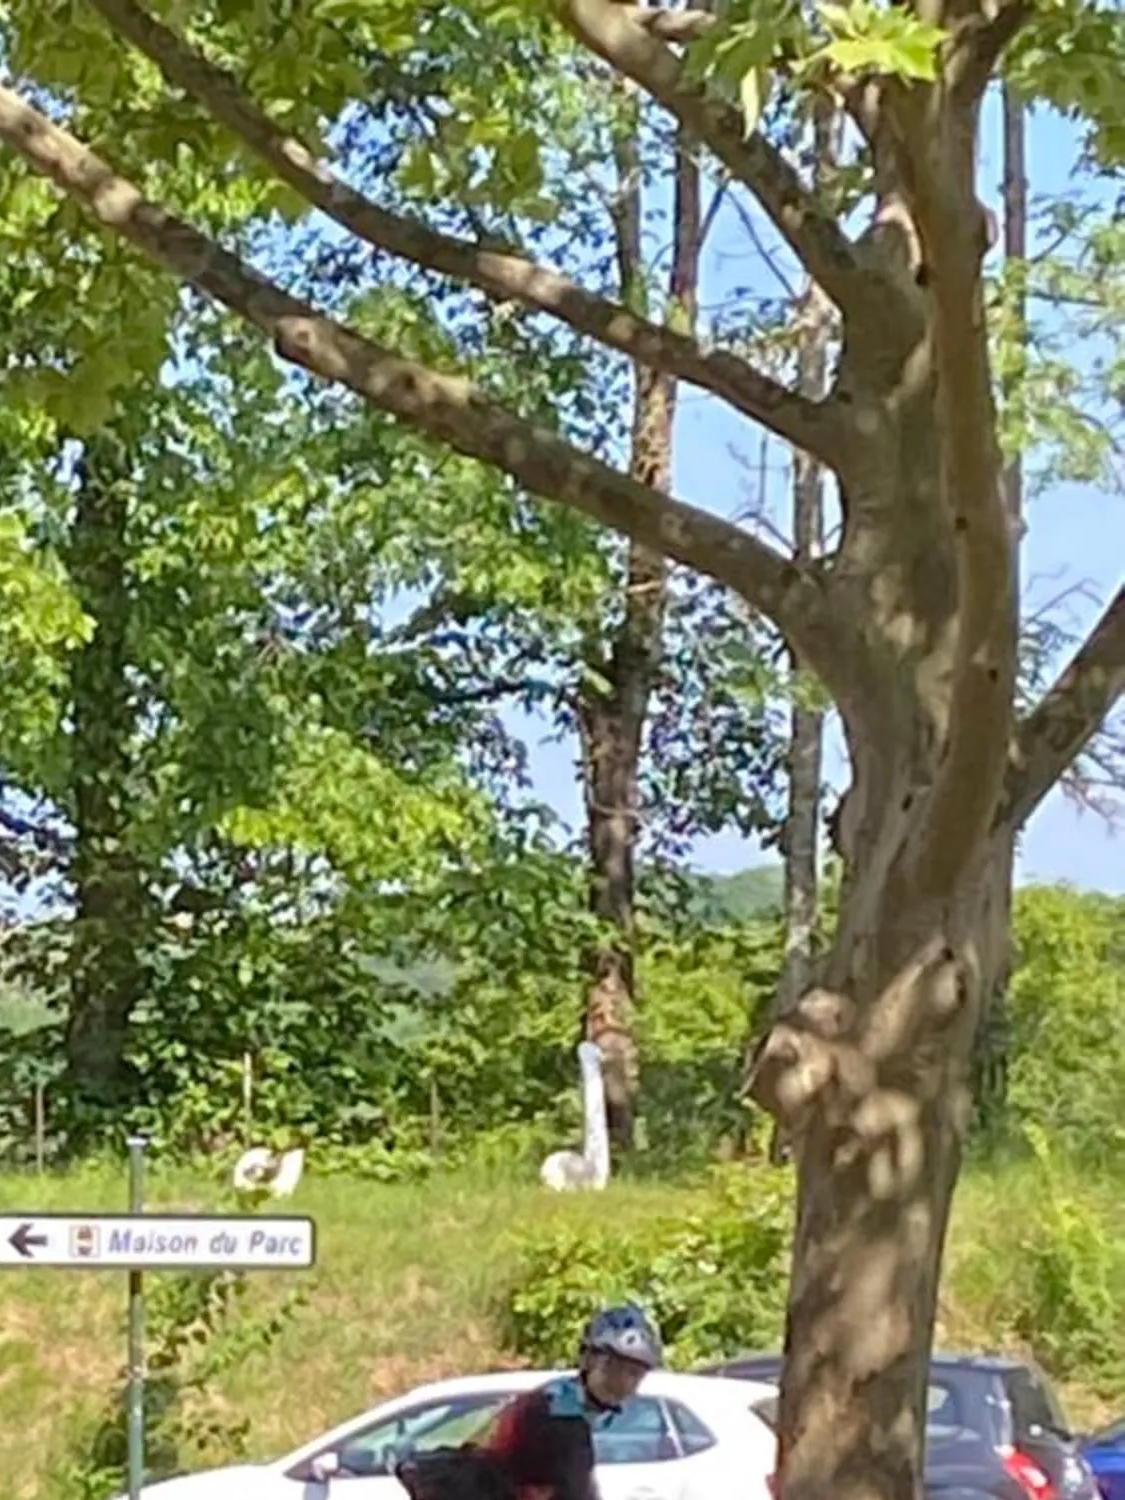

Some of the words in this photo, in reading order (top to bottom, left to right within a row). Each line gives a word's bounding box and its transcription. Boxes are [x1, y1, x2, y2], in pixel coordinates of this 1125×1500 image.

[108, 1229, 198, 1254] Maison
[209, 1230, 237, 1254] du
[248, 1230, 304, 1256] Parc
